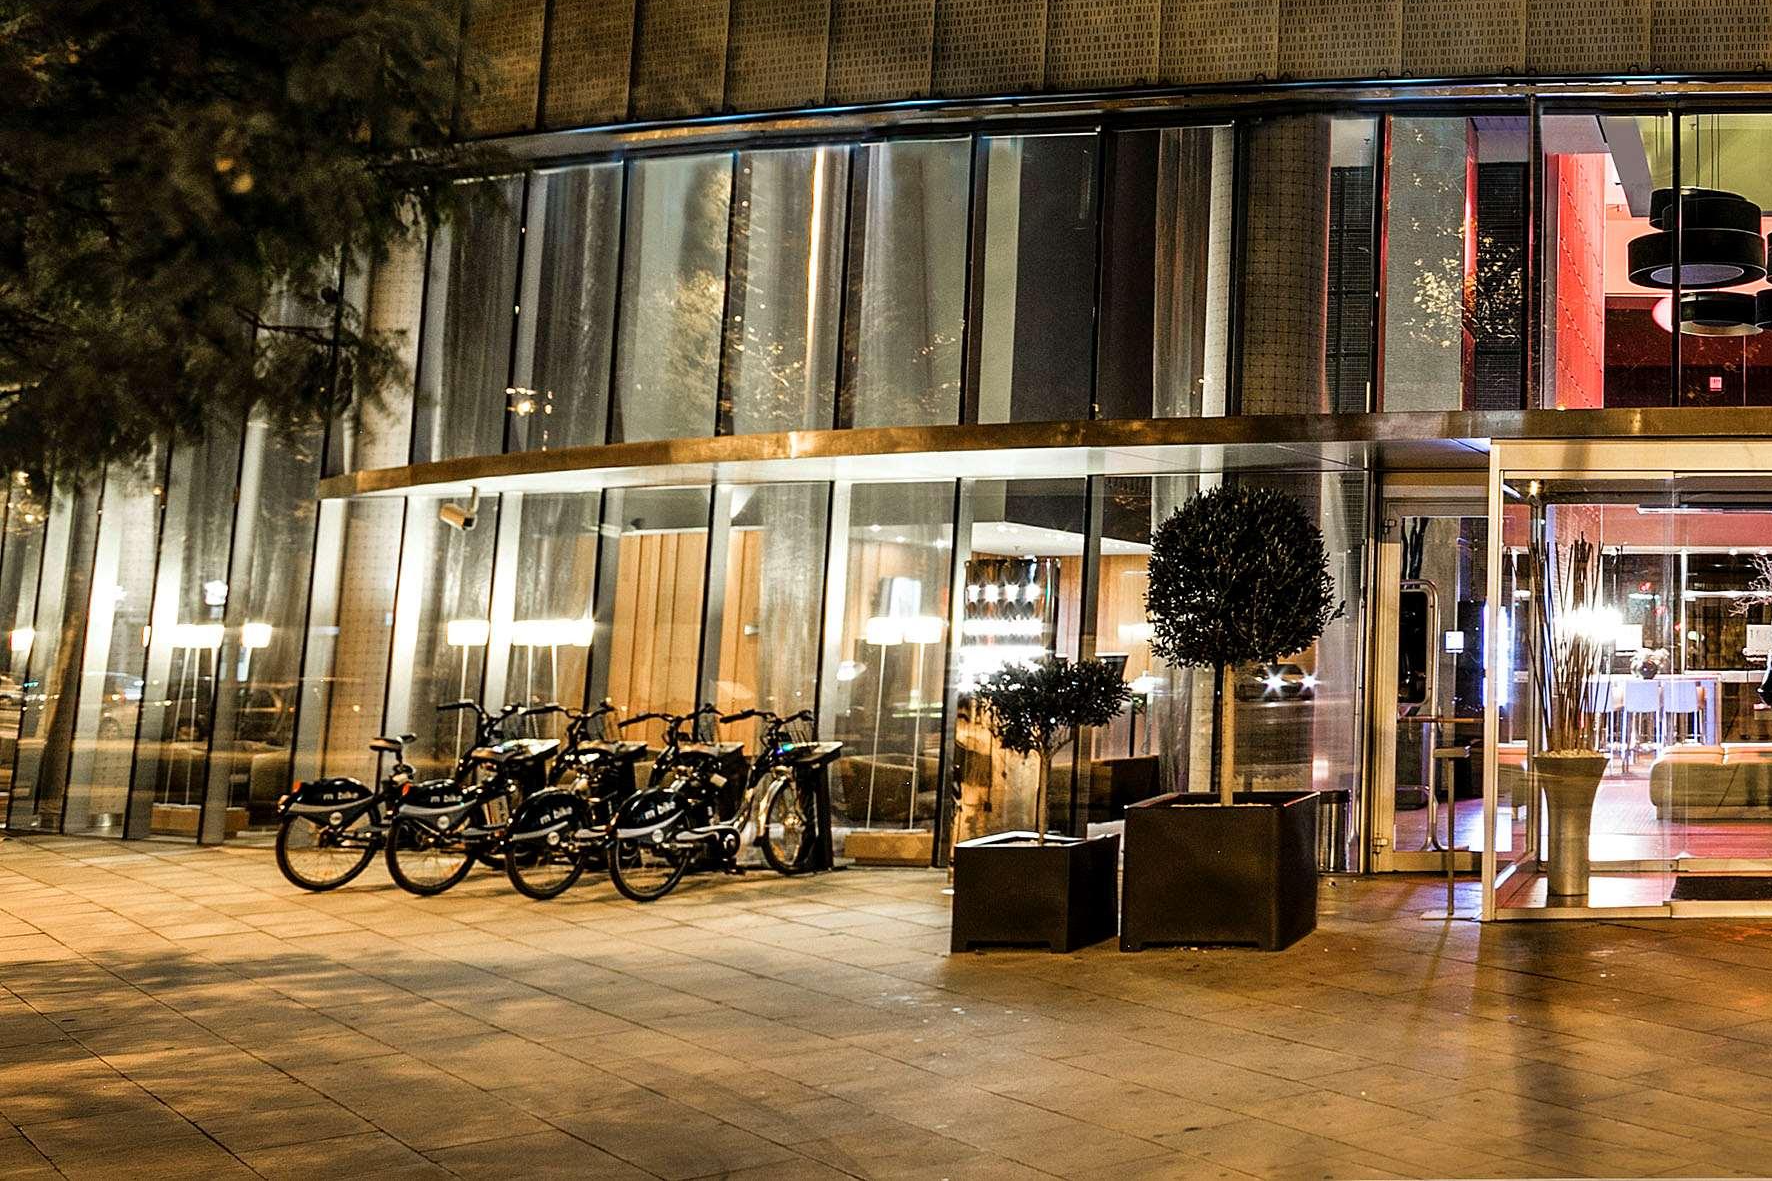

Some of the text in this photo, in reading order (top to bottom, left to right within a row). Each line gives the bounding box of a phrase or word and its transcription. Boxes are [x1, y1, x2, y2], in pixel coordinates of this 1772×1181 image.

[338, 791, 359, 800] bike
[443, 793, 464, 803] bike
[553, 805, 573, 820] bike
[657, 801, 676, 815] bike
